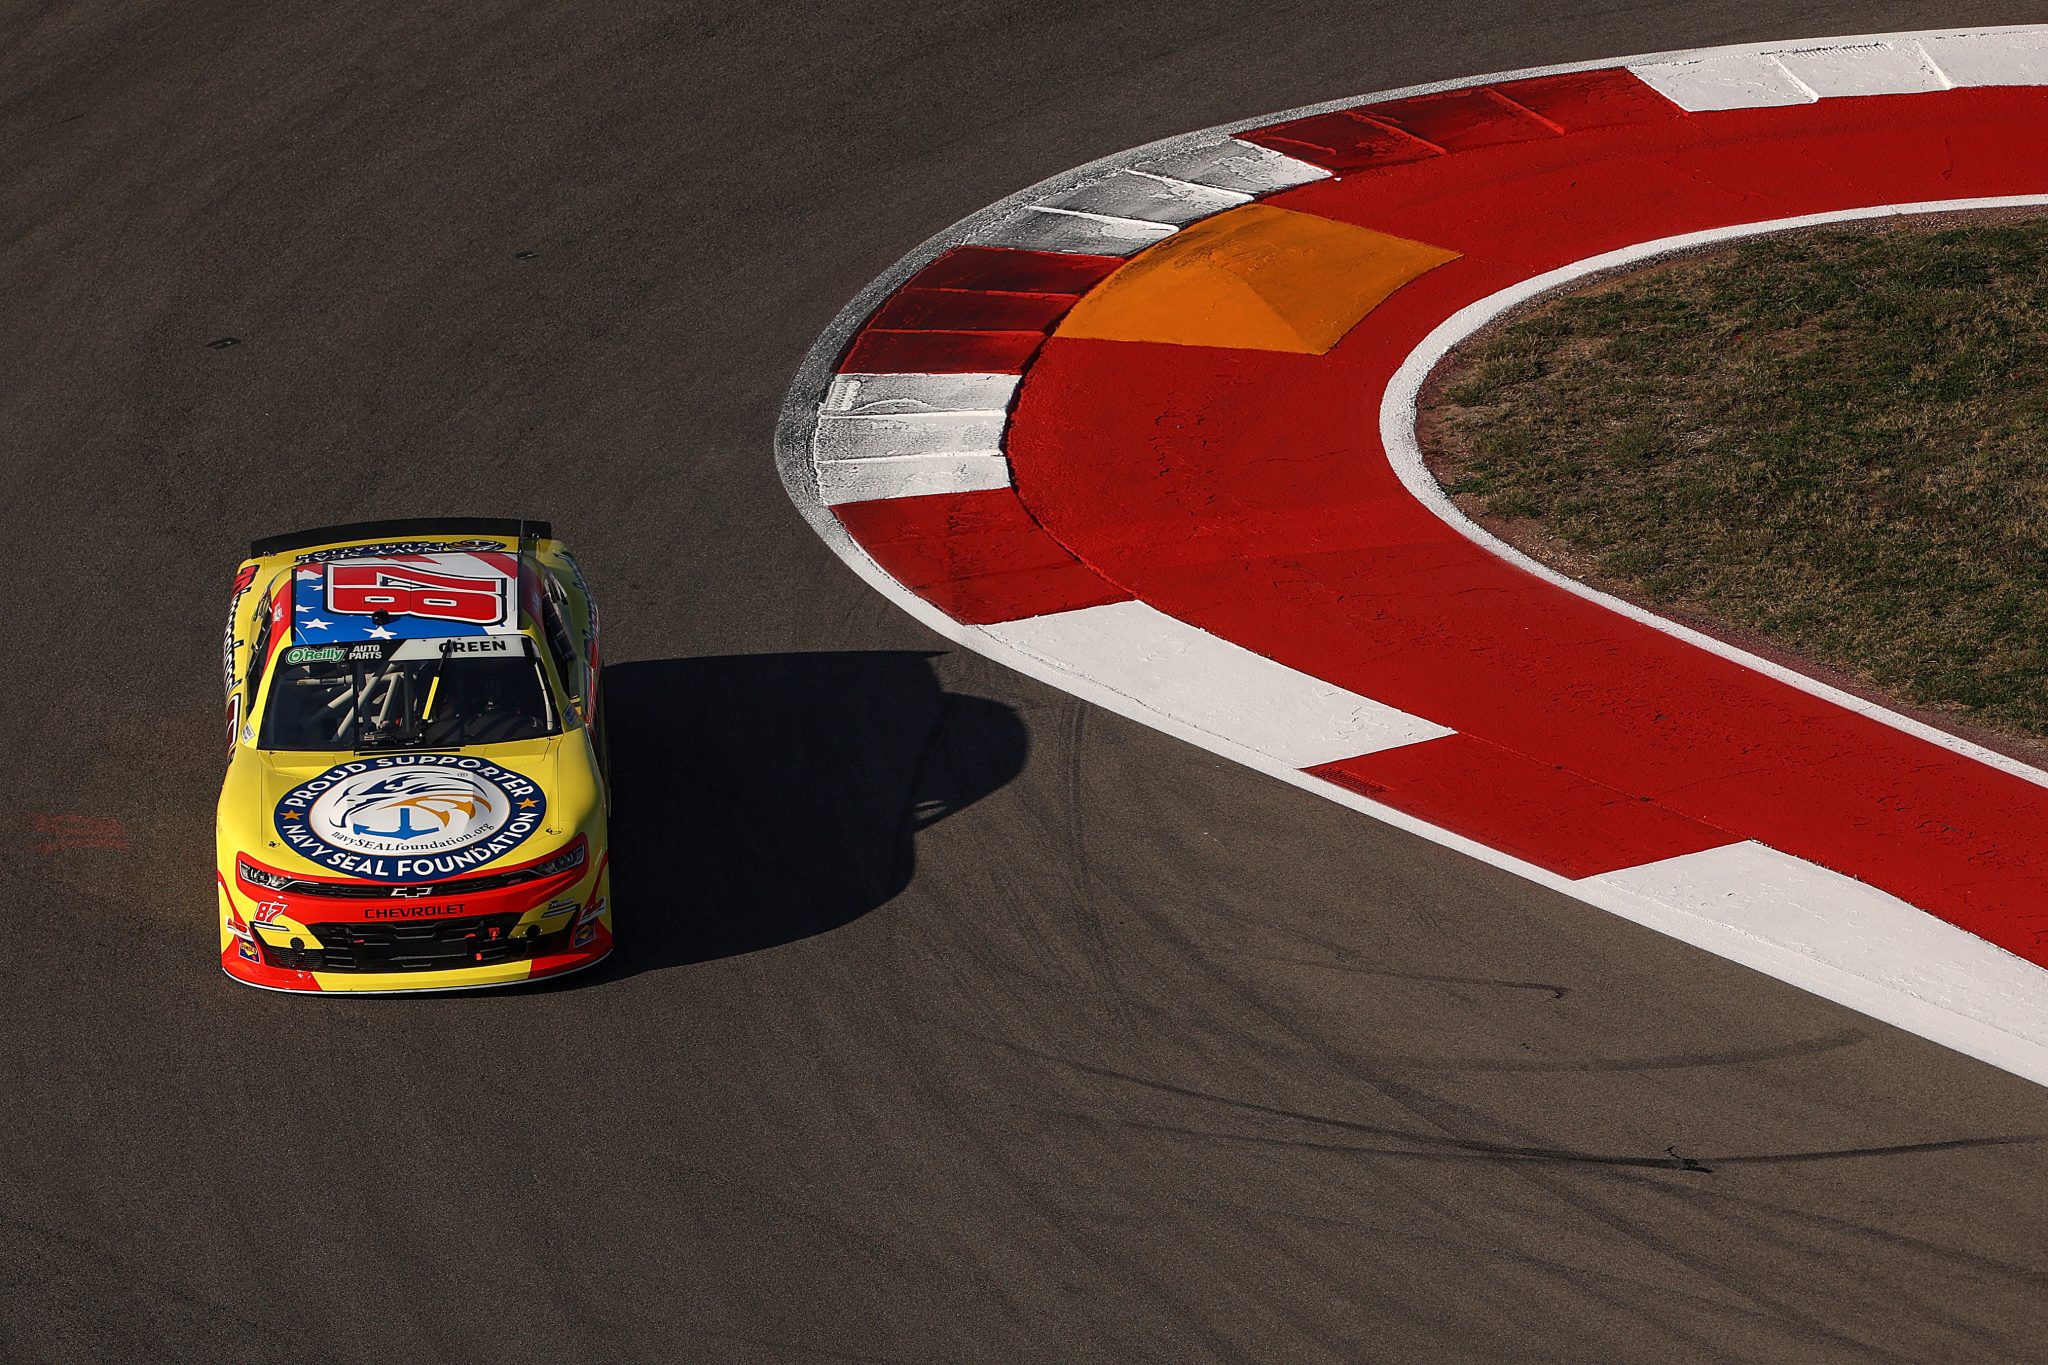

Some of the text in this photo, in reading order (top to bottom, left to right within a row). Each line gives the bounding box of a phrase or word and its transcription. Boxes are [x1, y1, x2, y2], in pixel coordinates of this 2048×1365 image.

[326, 563, 505, 625] 87
[287, 647, 347, 664] O'Reilly
[349, 652, 382, 660] PARTS
[353, 645, 380, 653] AUTO
[439, 641, 507, 653] GREEN
[284, 756, 534, 808] PROUD SUPPORTER
[283, 812, 539, 877] NAVY SEAL FOUNDATION
[332, 823, 495, 852] navySEALfoundation.org
[254, 901, 288, 925] 87
[364, 903, 466, 919] CHEVROLET
